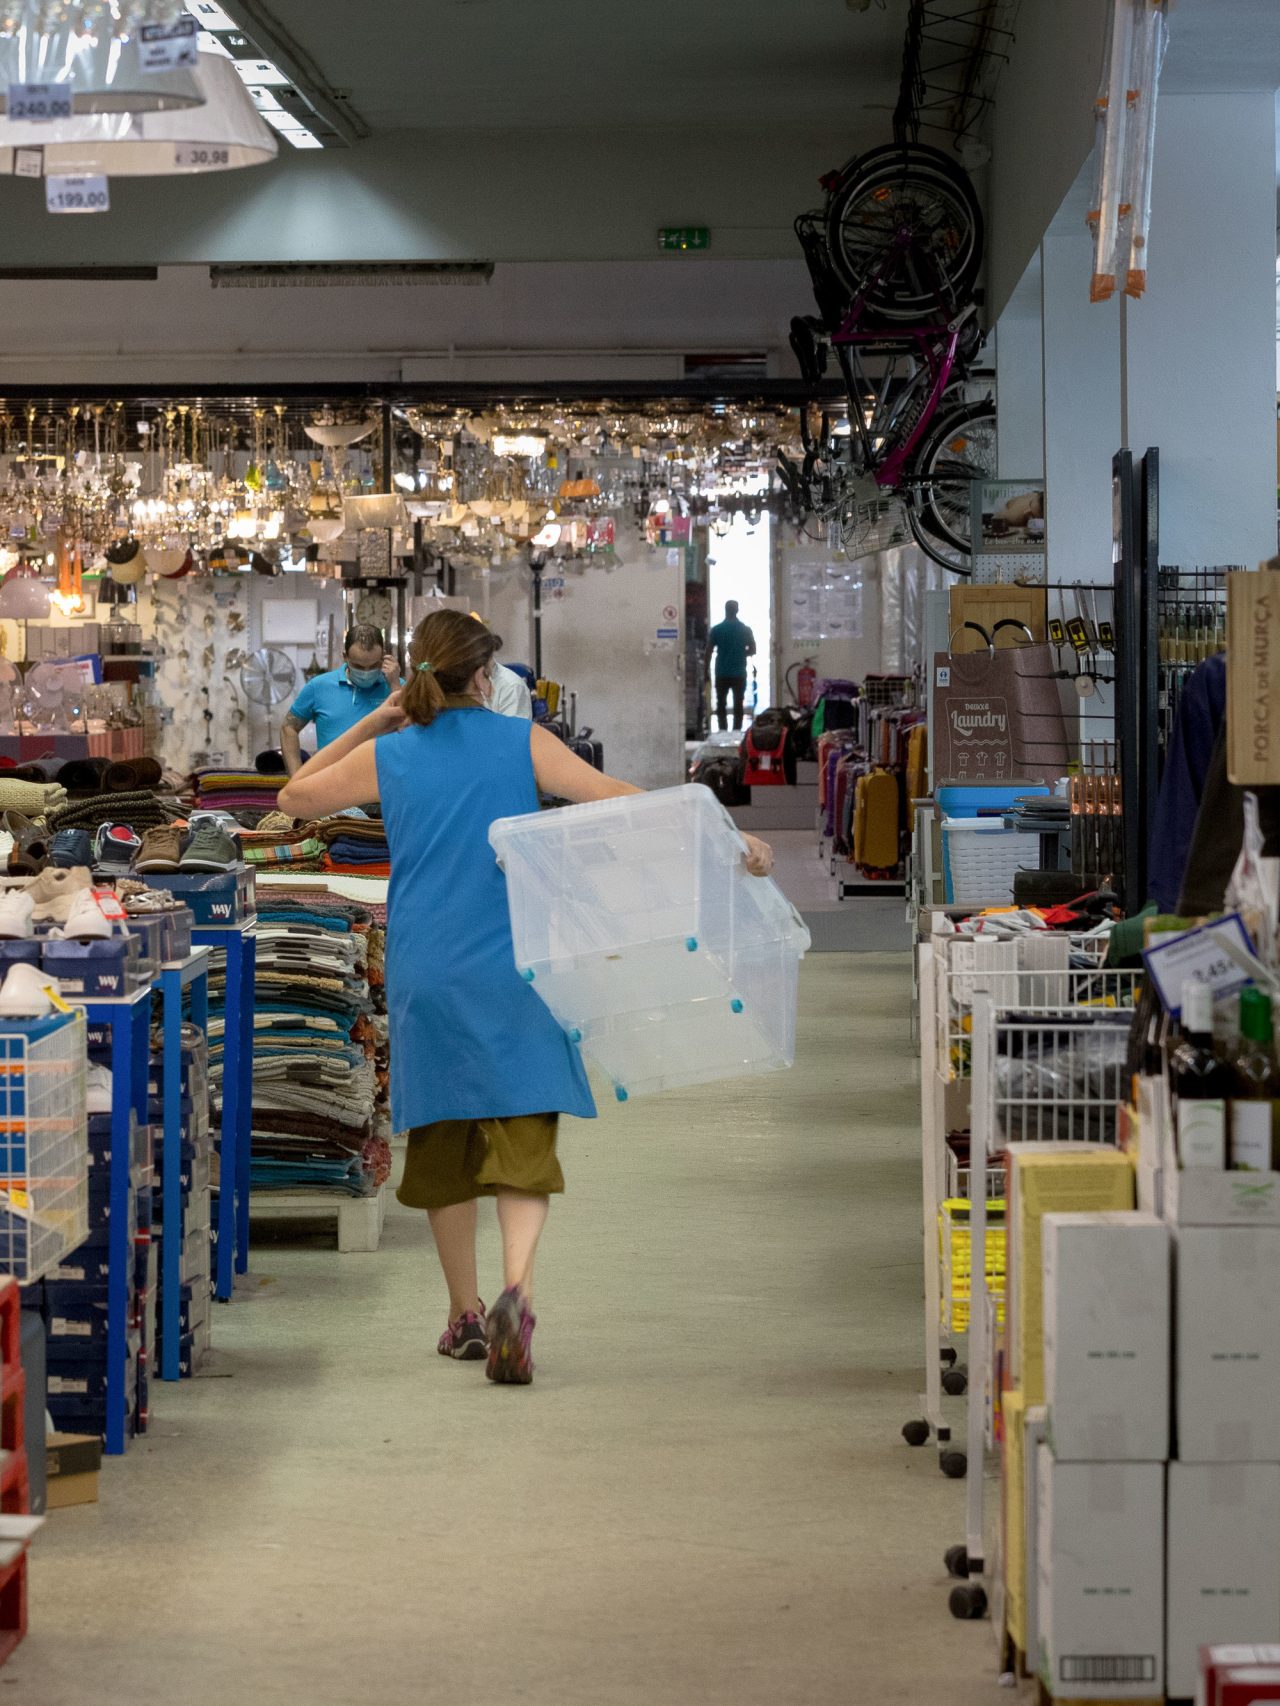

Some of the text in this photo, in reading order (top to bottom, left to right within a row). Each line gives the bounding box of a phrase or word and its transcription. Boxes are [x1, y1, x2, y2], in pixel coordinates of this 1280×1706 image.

[191, 150, 229, 165] 30,98
[1254, 593, 1272, 669] MURÇA
[950, 710, 1007, 737] Laundry
[1254, 694, 1269, 763] PORCA
